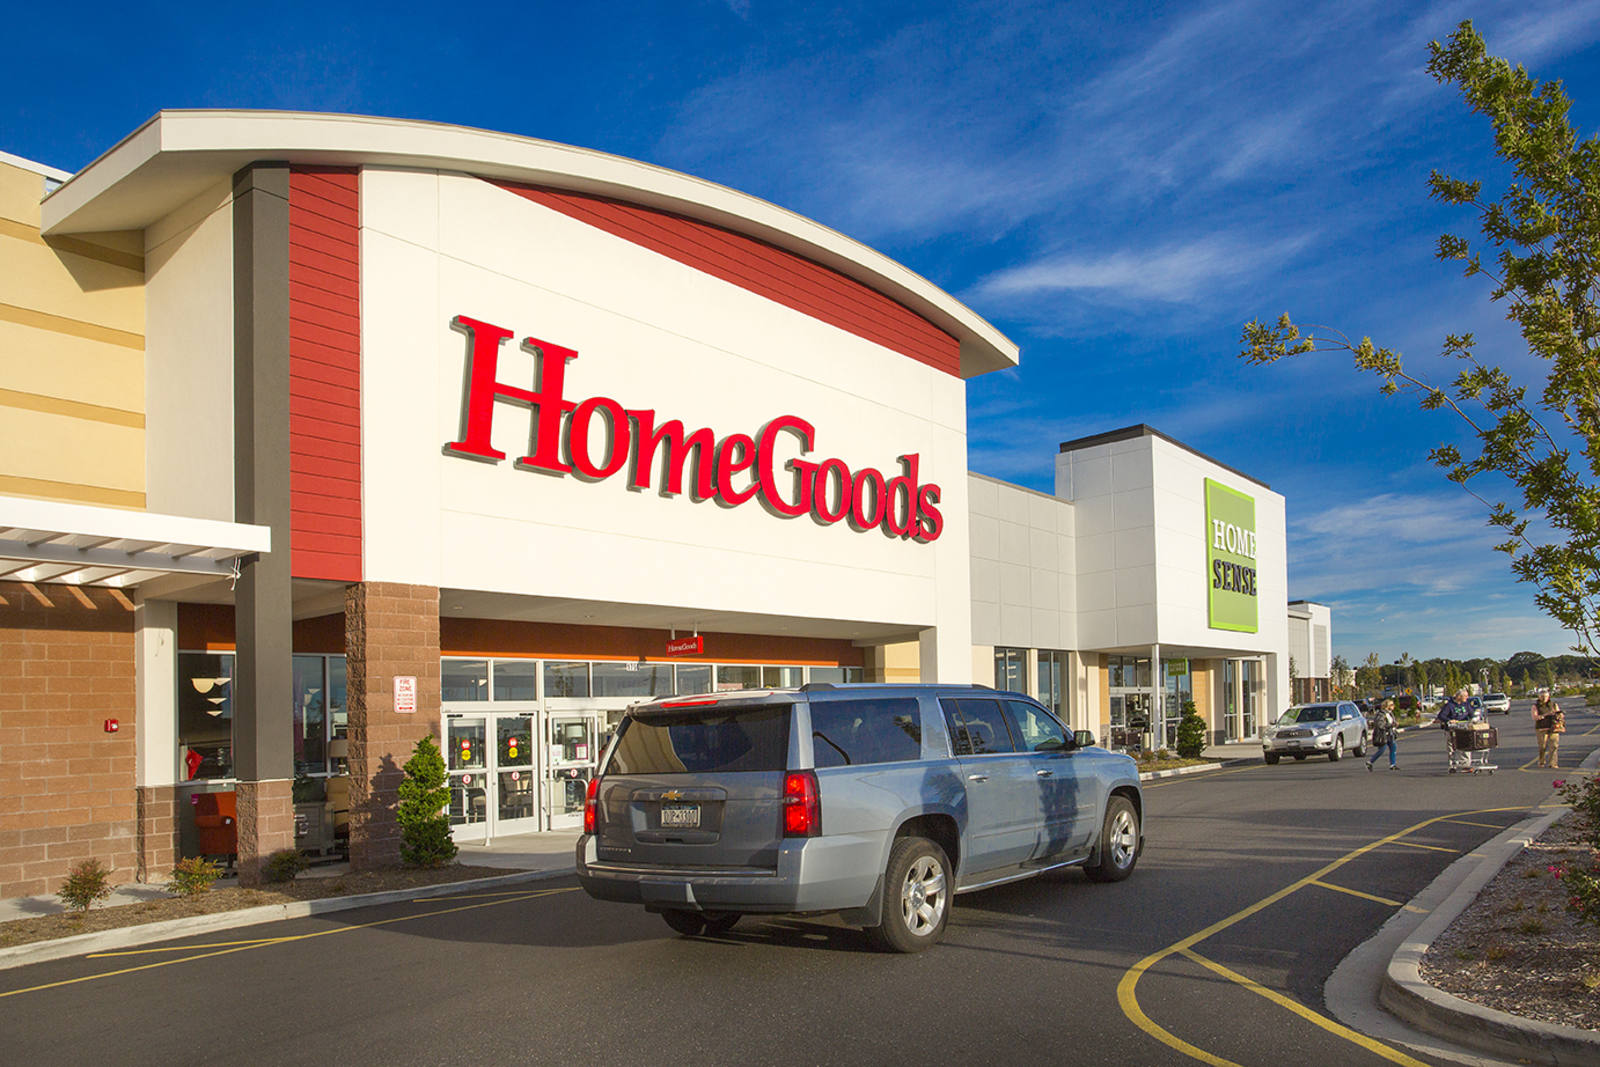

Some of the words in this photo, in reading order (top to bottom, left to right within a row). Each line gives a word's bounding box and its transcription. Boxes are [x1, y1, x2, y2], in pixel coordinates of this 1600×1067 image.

[443, 315, 943, 543] HomeGoods
[1212, 518, 1257, 560] HOME
[1213, 558, 1257, 597] SENSE
[667, 642, 697, 653] HomeGoods
